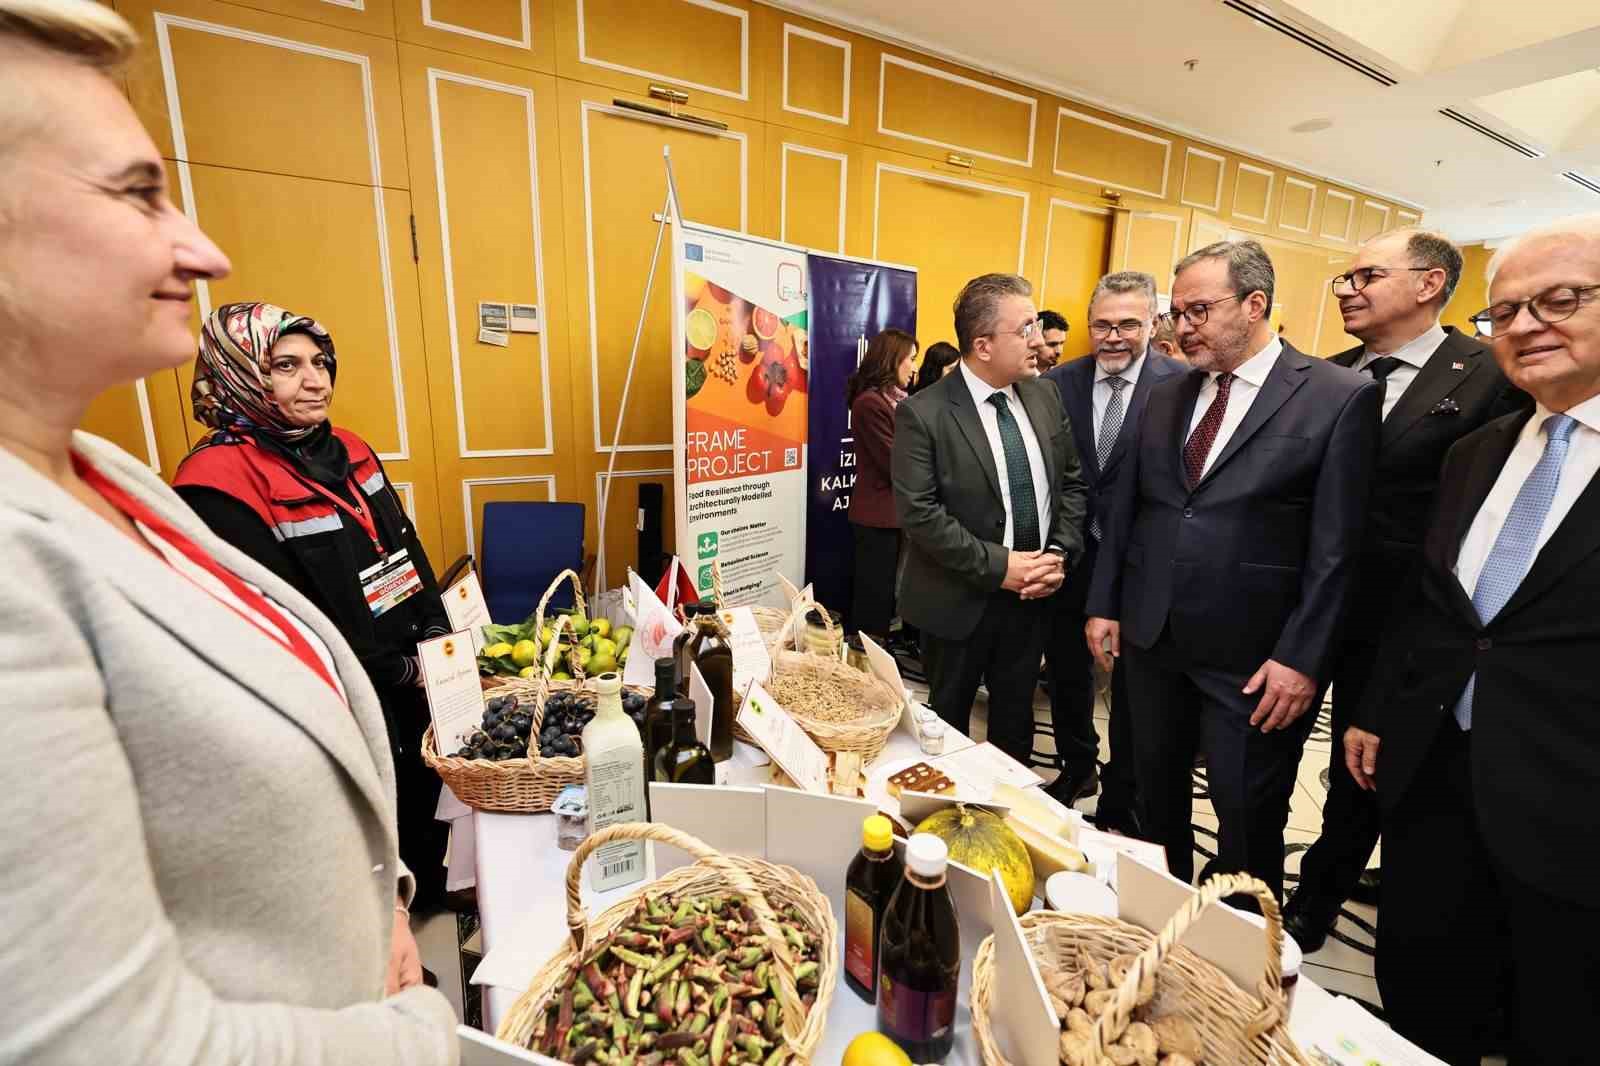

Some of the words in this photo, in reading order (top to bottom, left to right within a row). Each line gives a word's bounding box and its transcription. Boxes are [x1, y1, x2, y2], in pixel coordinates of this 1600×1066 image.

[687, 429, 747, 454] FRAME
[687, 450, 772, 480] PROJECT
[840, 450, 857, 467] İZ
[705, 485, 742, 498] Resilience
[742, 480, 770, 491] through
[821, 473, 858, 491] KALK
[689, 495, 741, 512] Architecturally
[741, 490, 772, 502] Modelled
[832, 496, 850, 511] AJ
[689, 507, 738, 523] Environments
